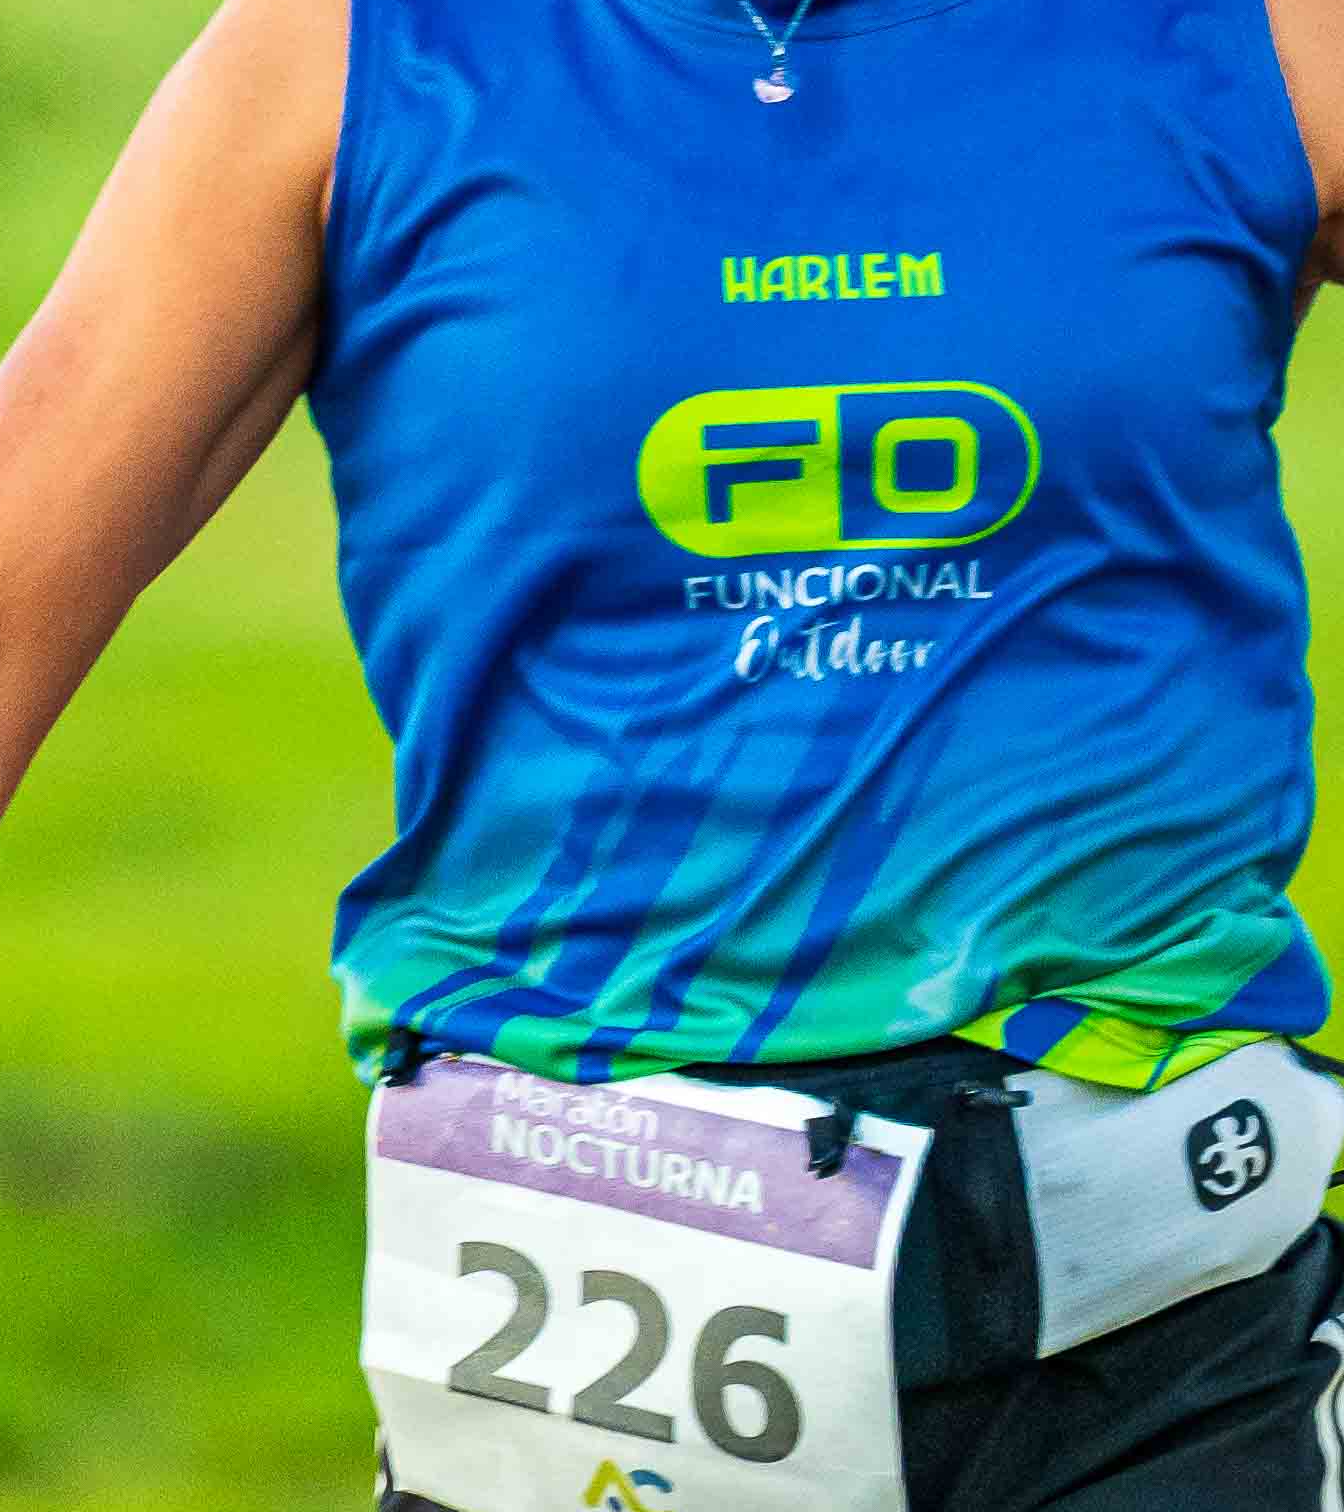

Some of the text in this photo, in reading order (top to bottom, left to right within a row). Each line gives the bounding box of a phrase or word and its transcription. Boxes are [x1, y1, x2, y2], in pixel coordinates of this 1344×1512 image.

[721, 251, 945, 304] HARLEM
[683, 559, 993, 610] FUNCIONAL
[489, 1113, 765, 1215] NOCTURNA
[447, 1241, 805, 1464] 226
